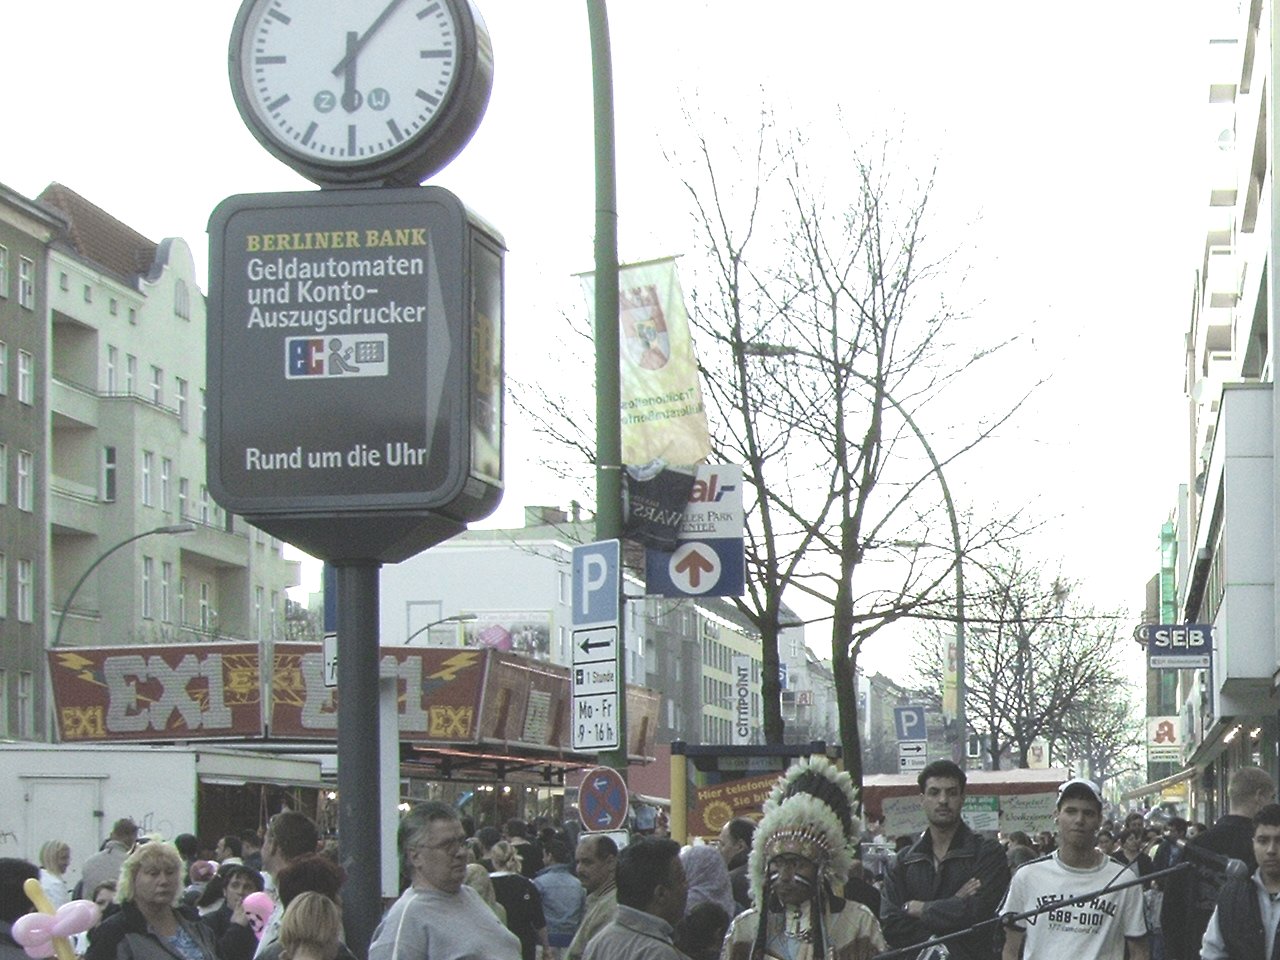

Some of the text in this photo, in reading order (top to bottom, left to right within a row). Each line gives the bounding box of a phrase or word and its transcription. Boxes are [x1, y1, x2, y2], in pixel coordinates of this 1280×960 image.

[246, 228, 427, 252] BERLINER BANK
[247, 255, 424, 281] Geldautomaten
[248, 280, 379, 305] und Konto-
[247, 301, 427, 333] Auszugsdrucker
[246, 446, 426, 472] Rund um die Uhr
[681, 523, 716, 532] ENTER
[583, 553, 607, 615] P
[1155, 630, 1205, 647] SEB
[592, 670, 615, 683] Stunde
[579, 701, 593, 719] Mo
[602, 698, 613, 716] Fr
[579, 724, 586, 742] 9
[595, 723, 605, 740] 16
[606, 721, 613, 738] h
[901, 710, 918, 736] P
[698, 789, 722, 800] Hier
[733, 796, 751, 806] Sie
[1049, 910, 1104, 926] 688-0101
[1090, 898, 1117, 917] HALL
